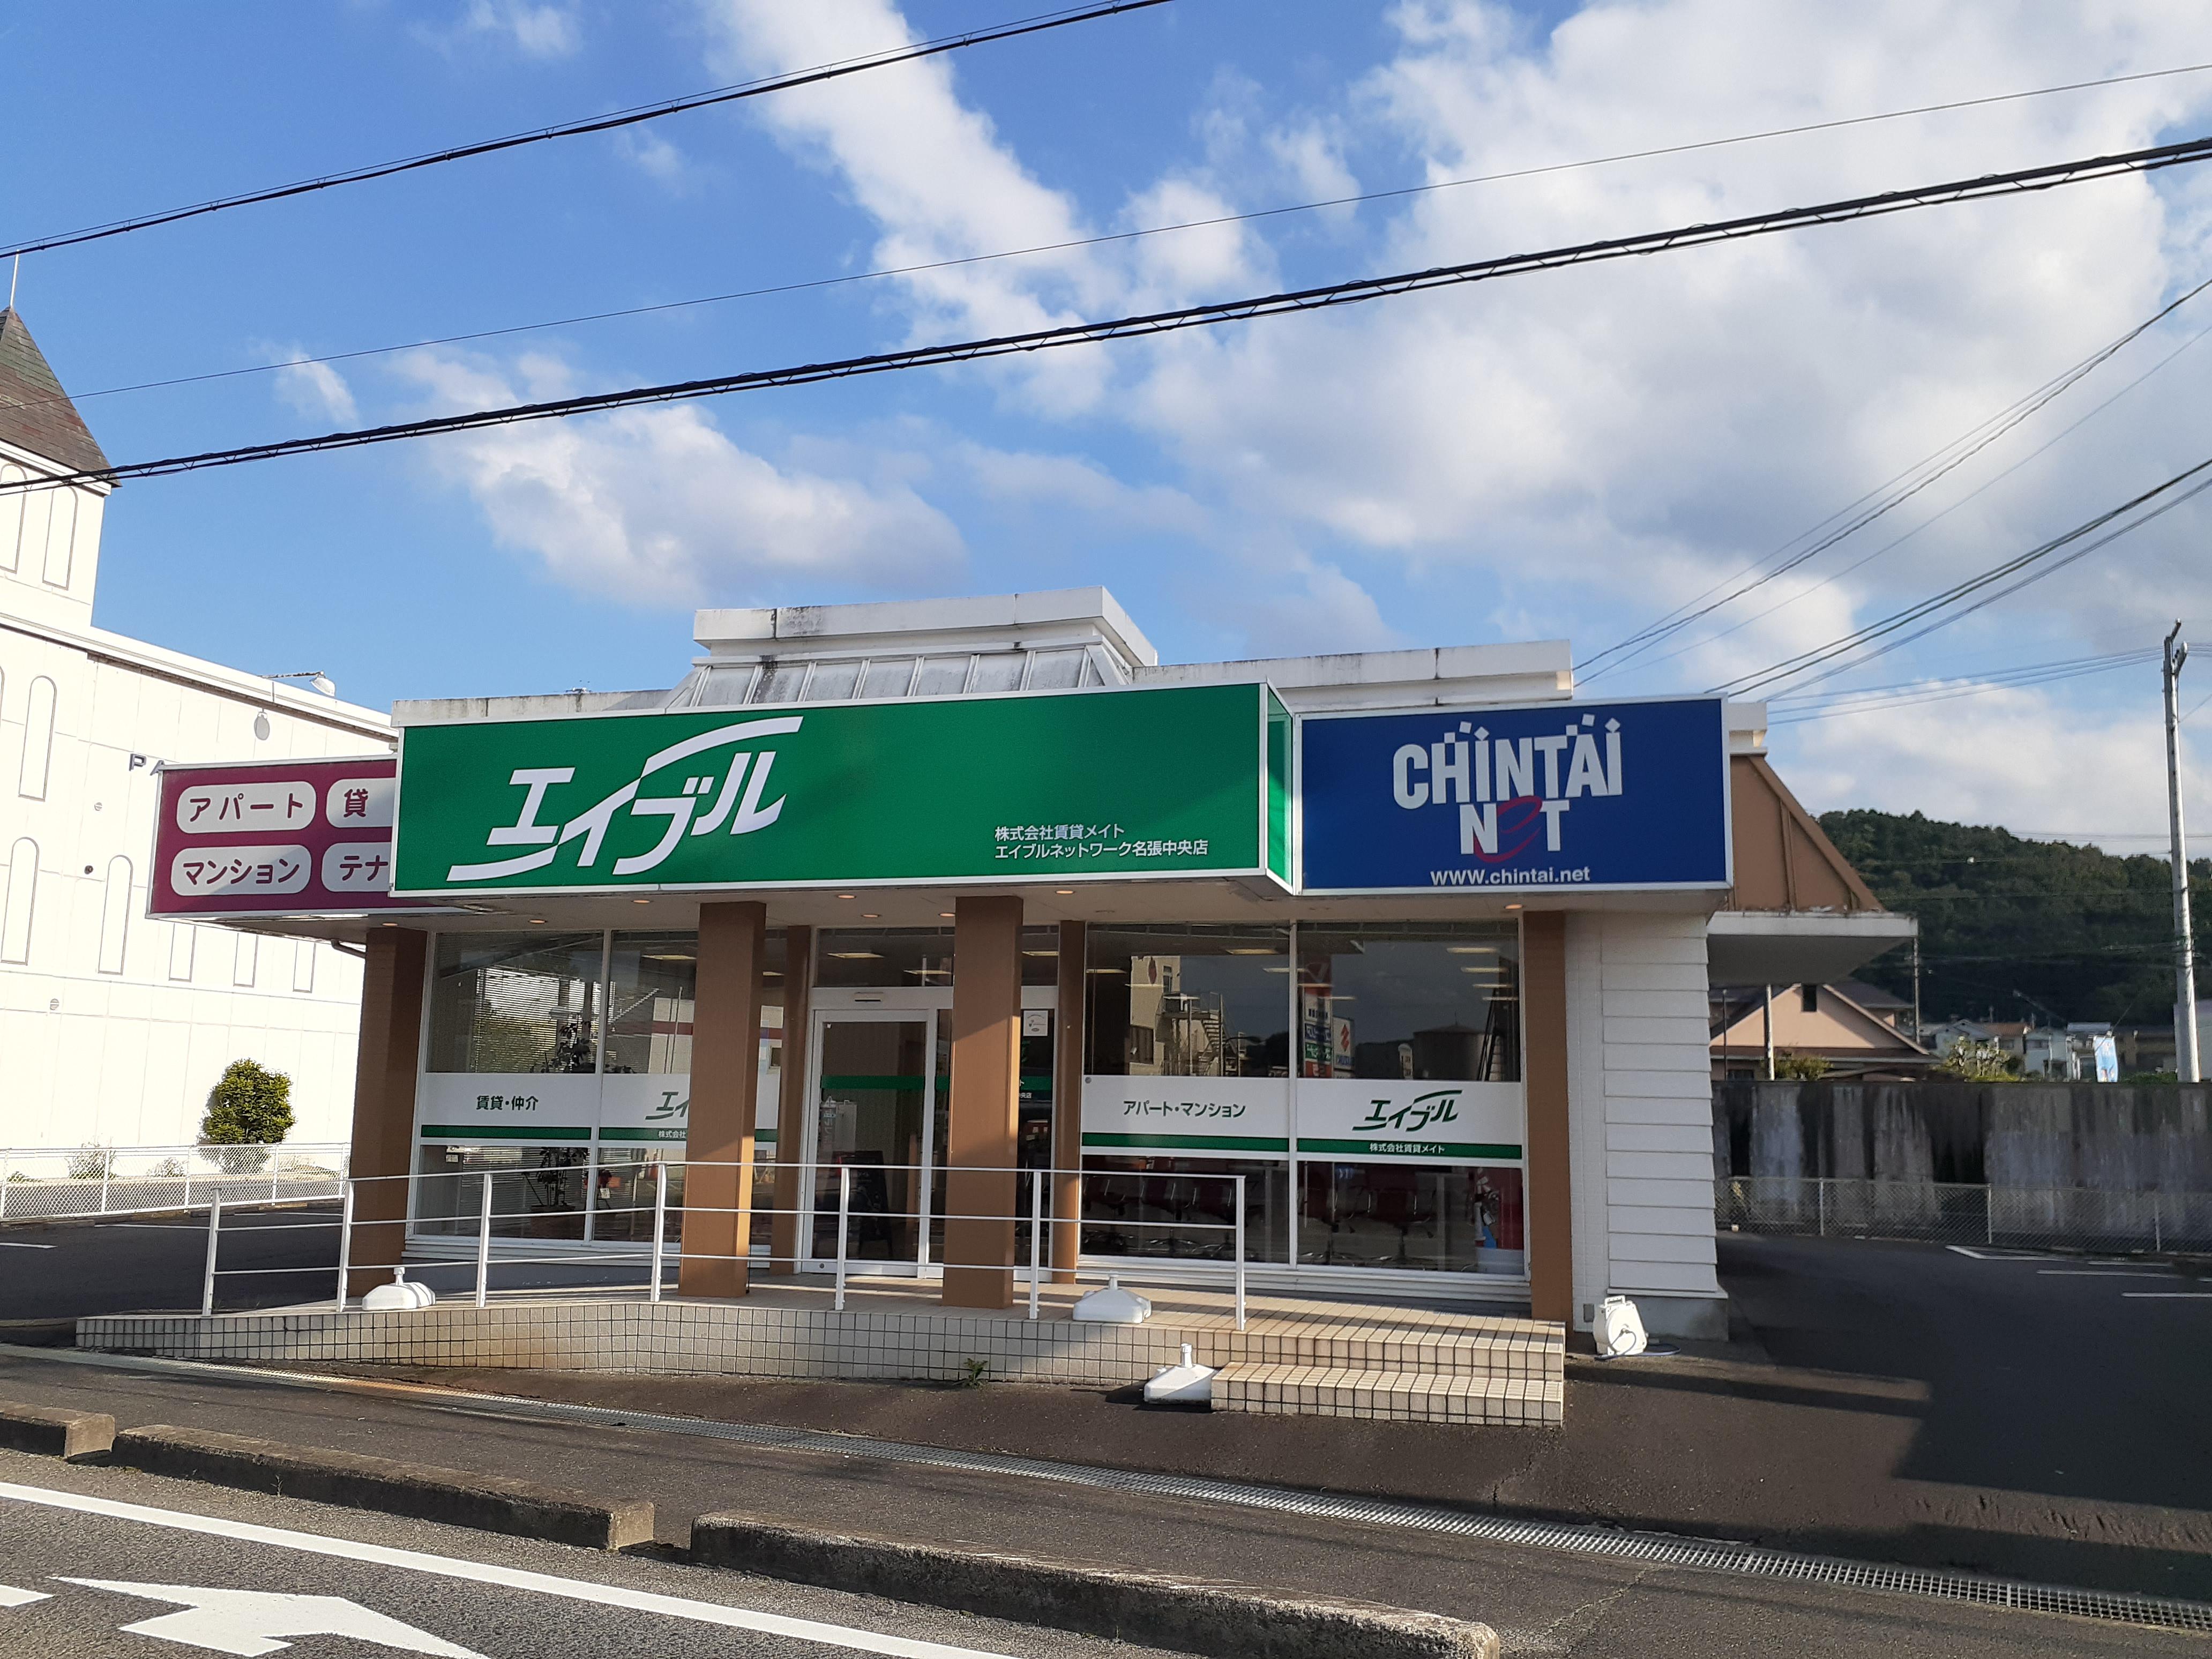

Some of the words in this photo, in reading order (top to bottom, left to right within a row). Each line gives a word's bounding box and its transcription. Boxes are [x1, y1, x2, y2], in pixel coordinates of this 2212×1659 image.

[190, 793, 303, 822] アパート
[343, 788, 368, 818] 貸
[446, 716, 804, 881] エイブル
[995, 824, 1124, 841] 株式会社賃貸メイト
[995, 839, 1208, 859] エイブルネットワーク名張中央店
[183, 858, 300, 885] マンション
[339, 855, 388, 881] テナ
[476, 1095, 539, 1111] 賃貸・仲介
[1124, 1100, 1246, 1118] アパート・マンション
[1351, 1090, 1462, 1132] エイブル
[658, 1130, 686, 1138] 株式会社
